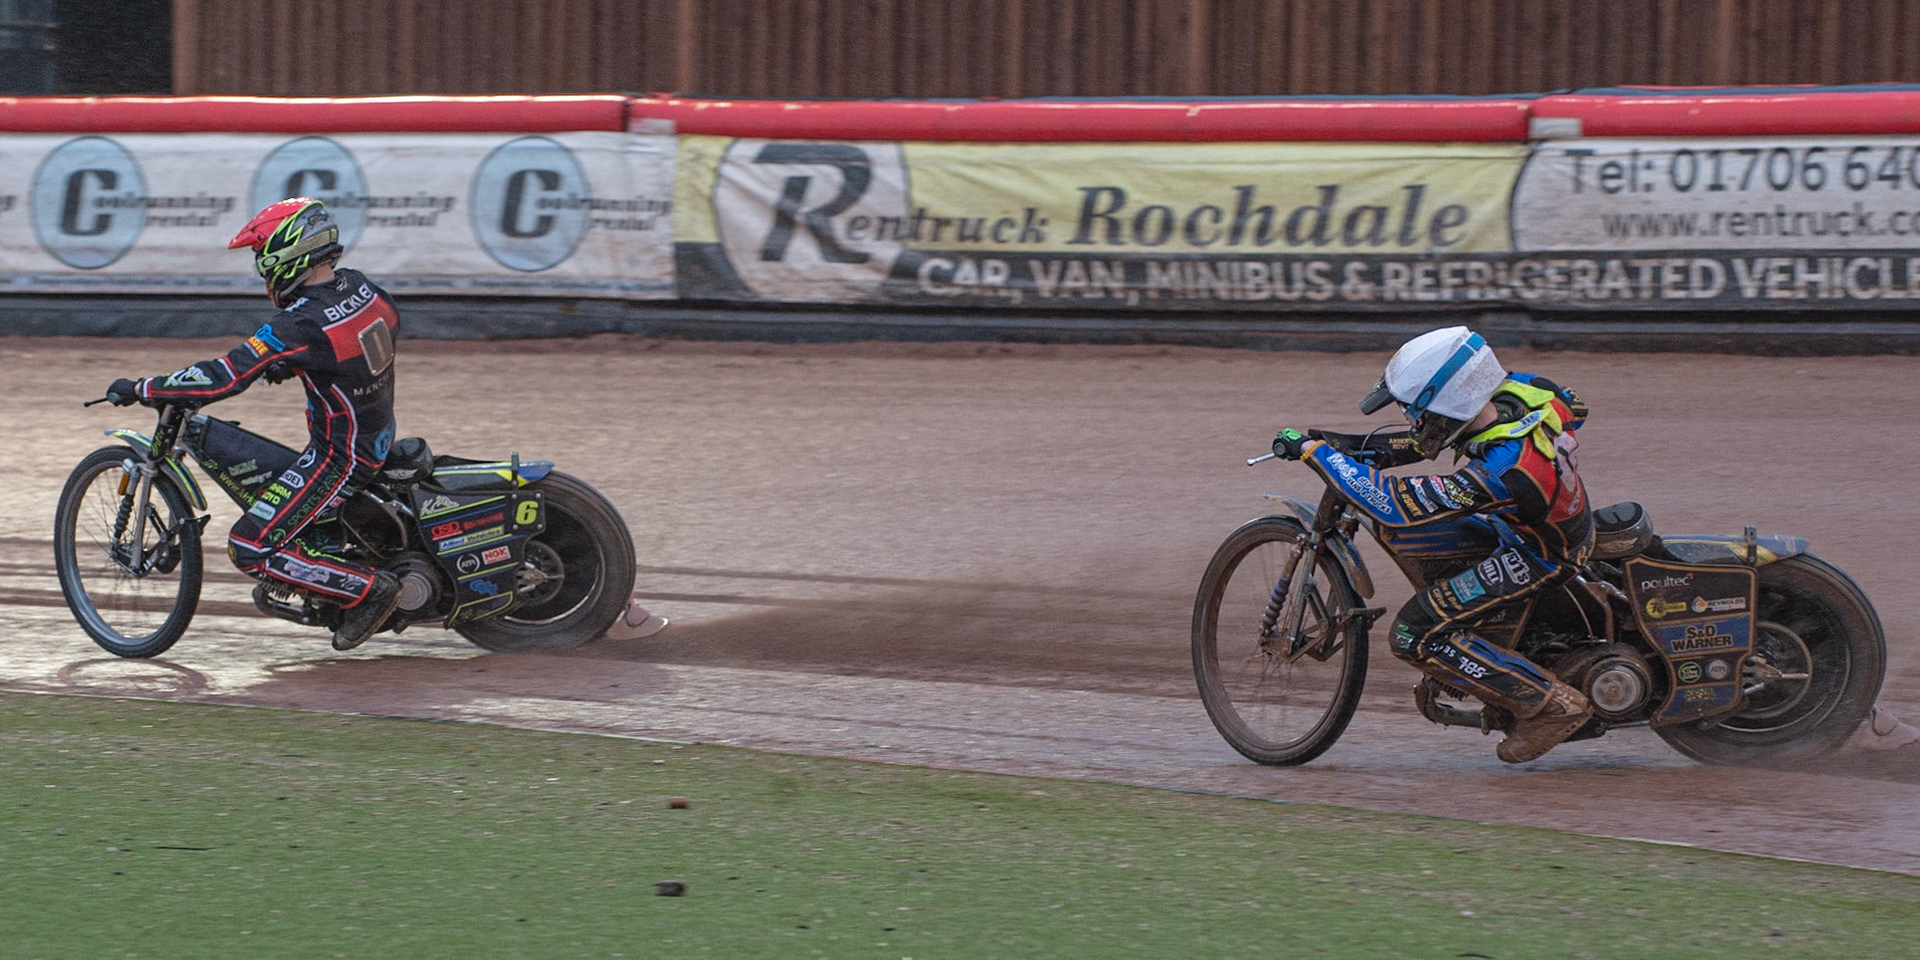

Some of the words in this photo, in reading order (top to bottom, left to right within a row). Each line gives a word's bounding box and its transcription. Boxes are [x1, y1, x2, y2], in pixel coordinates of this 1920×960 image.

[1563, 149, 1656, 194] Tel:
[1667, 147, 1826, 192] 01706
[753, 143, 1049, 264] Rentruck
[1066, 184, 1469, 248] Rochdale
[917, 257, 1022, 302] CAR,
[1030, 259, 1140, 305] VAN,
[1143, 259, 1333, 301] MINIBUS
[1340, 260, 1380, 300] &
[1382, 258, 1726, 301] REFRIGERATED
[323, 282, 374, 322] BICKLE
[515, 500, 539, 525] 6
[1367, 495, 1392, 514] TRUCKS
[484, 549, 507, 560] NGK
[1641, 575, 1690, 593] poultec
[1672, 635, 1732, 651] WARNER
[1686, 625, 1716, 639] S&D
